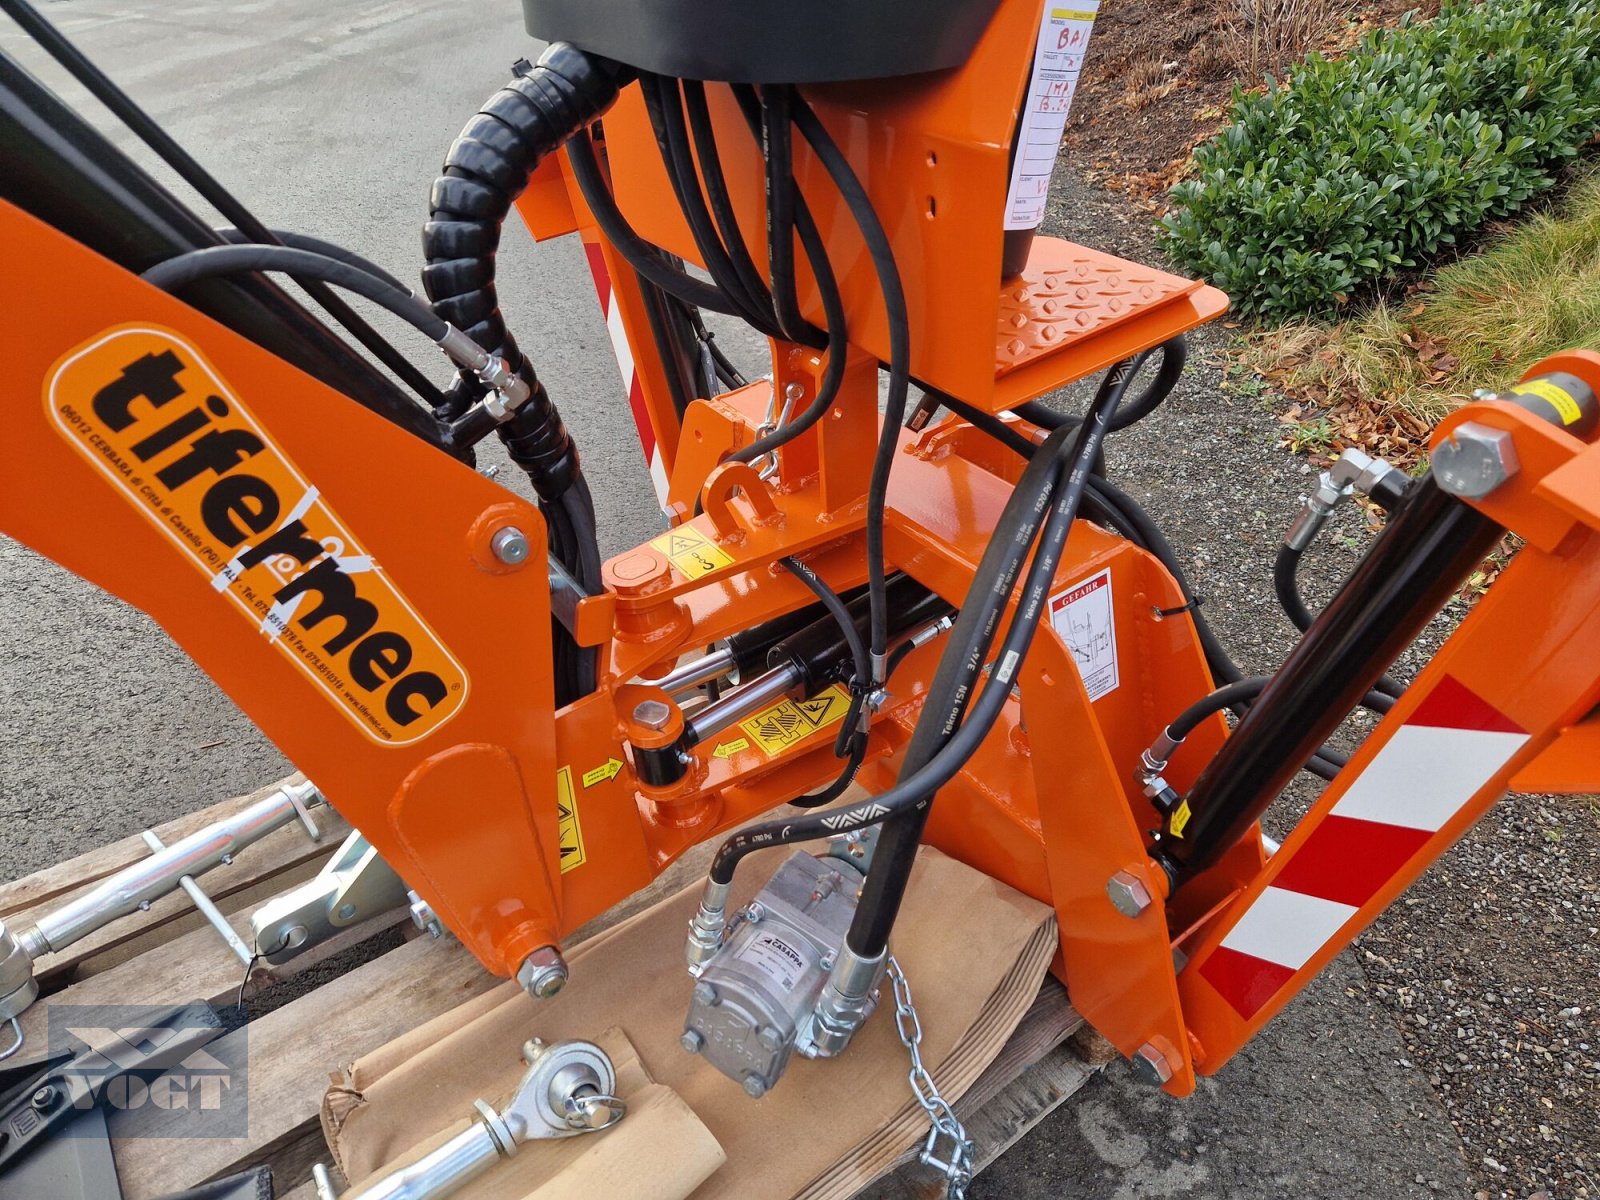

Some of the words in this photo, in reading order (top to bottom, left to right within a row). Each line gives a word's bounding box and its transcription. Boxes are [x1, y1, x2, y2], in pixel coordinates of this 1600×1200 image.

[1082, 443, 1092, 459] 4780
[1034, 494, 1047, 512] 1520
[1042, 481, 1052, 494] Psi
[93, 349, 447, 726] tifermec
[61, 404, 92, 435] 06012
[89, 433, 132, 476] CERBARA
[170, 514, 203, 547] Castello
[218, 562, 240, 584] ITALY
[295, 640, 307, 652] Fax
[344, 690, 392, 739] www.tifermec.com
[1025, 599, 1037, 620] Tekno
[1032, 585, 1042, 598] 2SC
[1042, 555, 1053, 571] 3/8"
[1062, 581, 1098, 606] GEFAHR
[942, 707, 959, 735] Tekno
[953, 685, 967, 704] 1SN
[966, 647, 981, 670] 3/4"
[772, 940, 802, 968] CASAPPA
